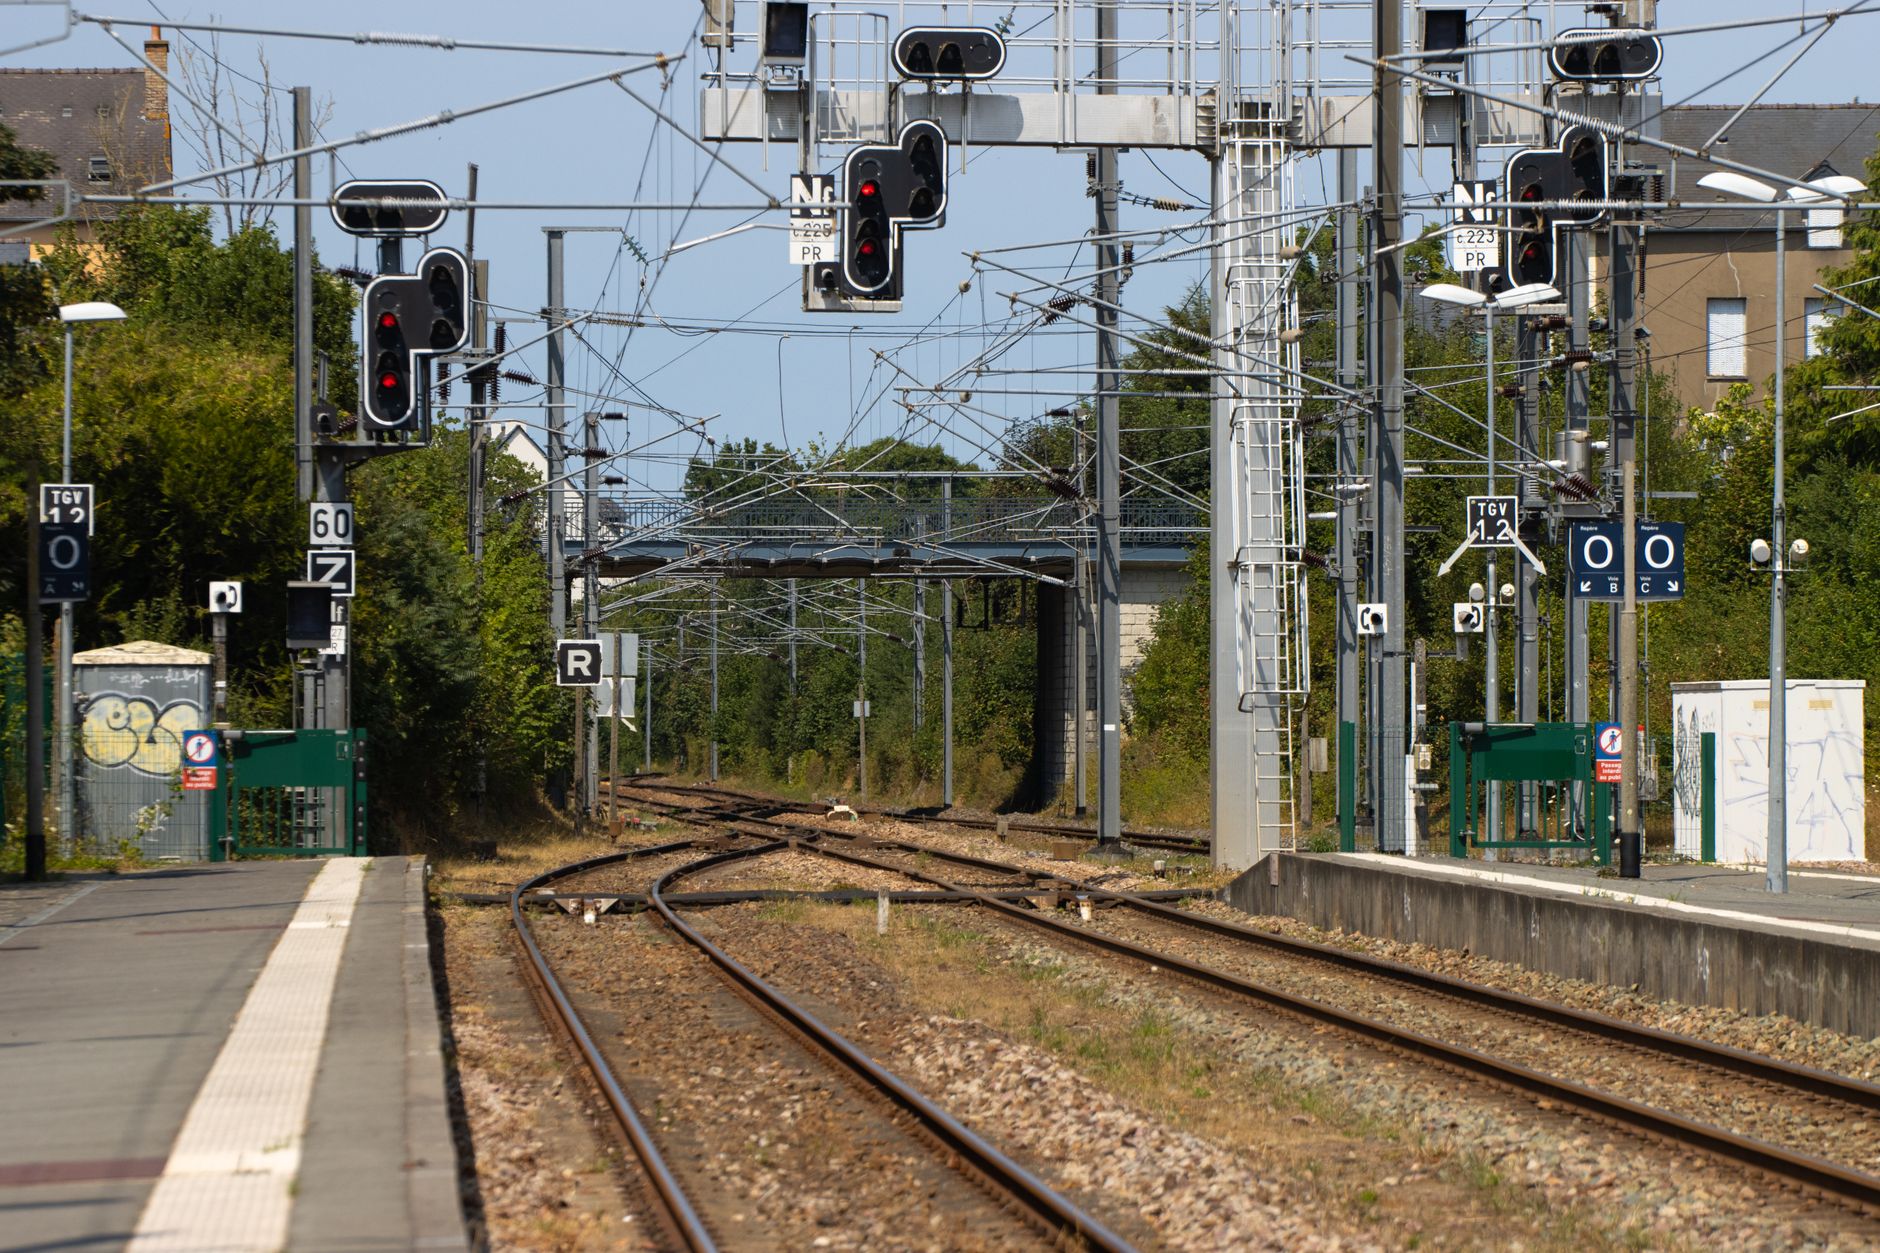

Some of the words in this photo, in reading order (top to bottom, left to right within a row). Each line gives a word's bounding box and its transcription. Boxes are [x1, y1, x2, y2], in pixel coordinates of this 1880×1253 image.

[792, 177, 834, 216] Nf
[1457, 230, 1495, 244] c.223
[802, 247, 822, 261] PR
[1466, 253, 1485, 267] PR
[51, 490, 83, 505] TGV
[1478, 503, 1508, 517] TGV
[313, 508, 350, 539] 60
[316, 556, 347, 590] Z
[1610, 583, 1618, 593] B
[1641, 583, 1650, 594] C
[567, 649, 592, 676] R
